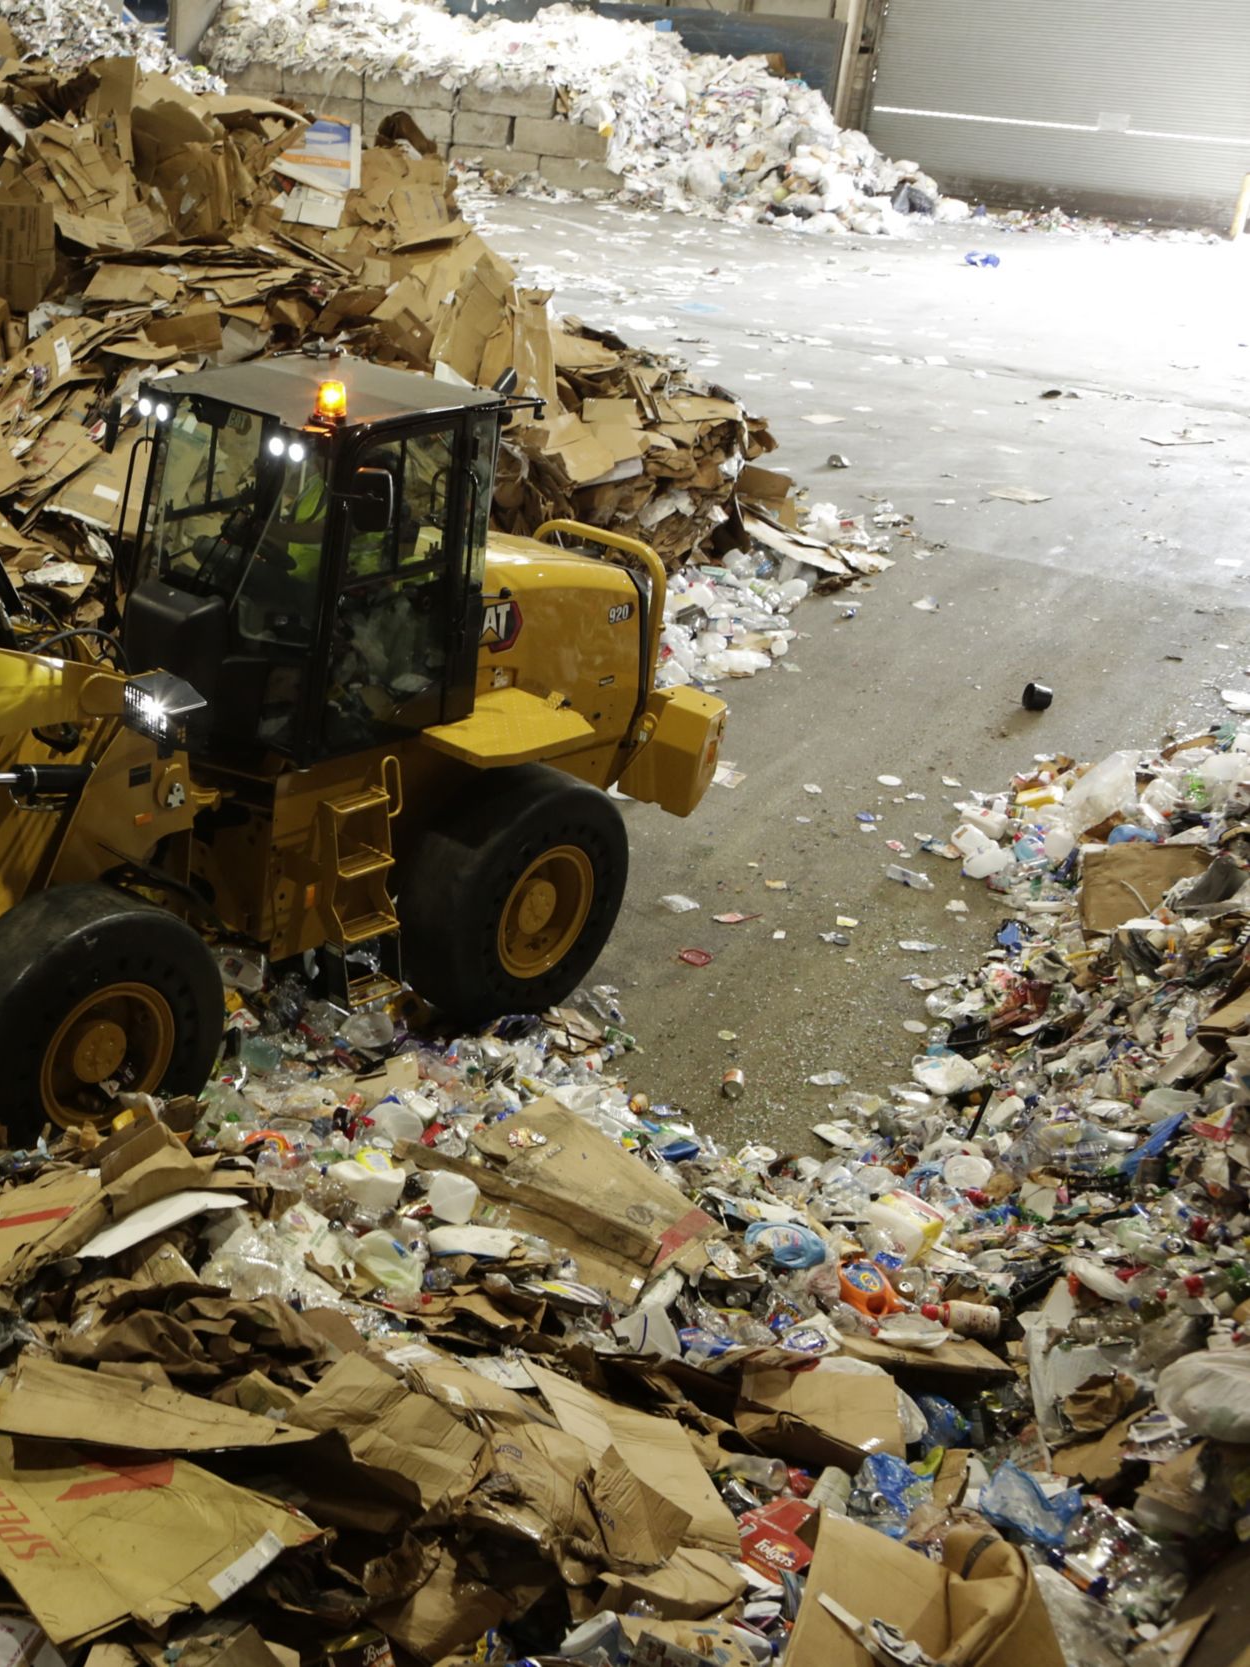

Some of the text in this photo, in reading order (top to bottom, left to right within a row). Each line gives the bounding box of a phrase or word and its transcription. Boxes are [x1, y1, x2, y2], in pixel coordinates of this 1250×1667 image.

[480, 602, 511, 641] AT
[609, 603, 630, 624] 920
[754, 1538, 796, 1567] Folgers
